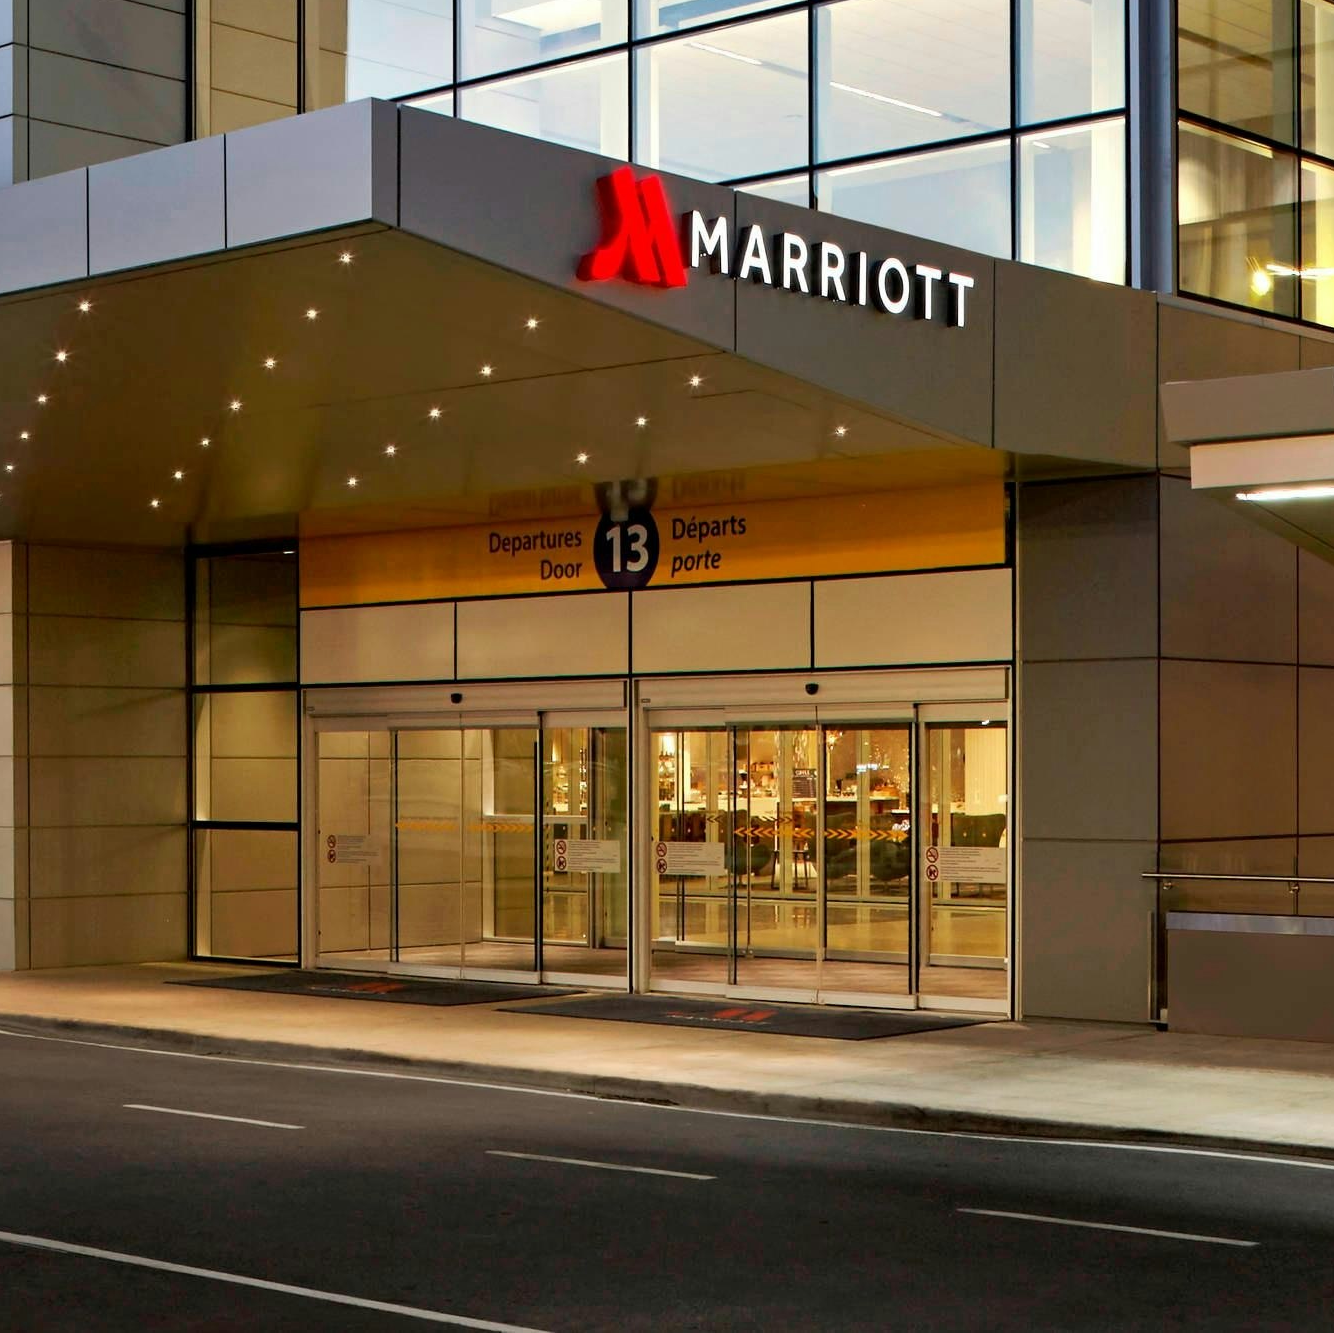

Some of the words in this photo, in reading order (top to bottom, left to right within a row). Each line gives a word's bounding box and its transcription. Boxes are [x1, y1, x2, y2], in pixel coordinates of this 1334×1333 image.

[691, 209, 975, 328] MARRIOTT
[489, 530, 582, 557] Departures
[671, 515, 747, 544] Départs
[605, 523, 650, 573] 13
[540, 559, 583, 580] Door
[670, 549, 722, 578] porte
